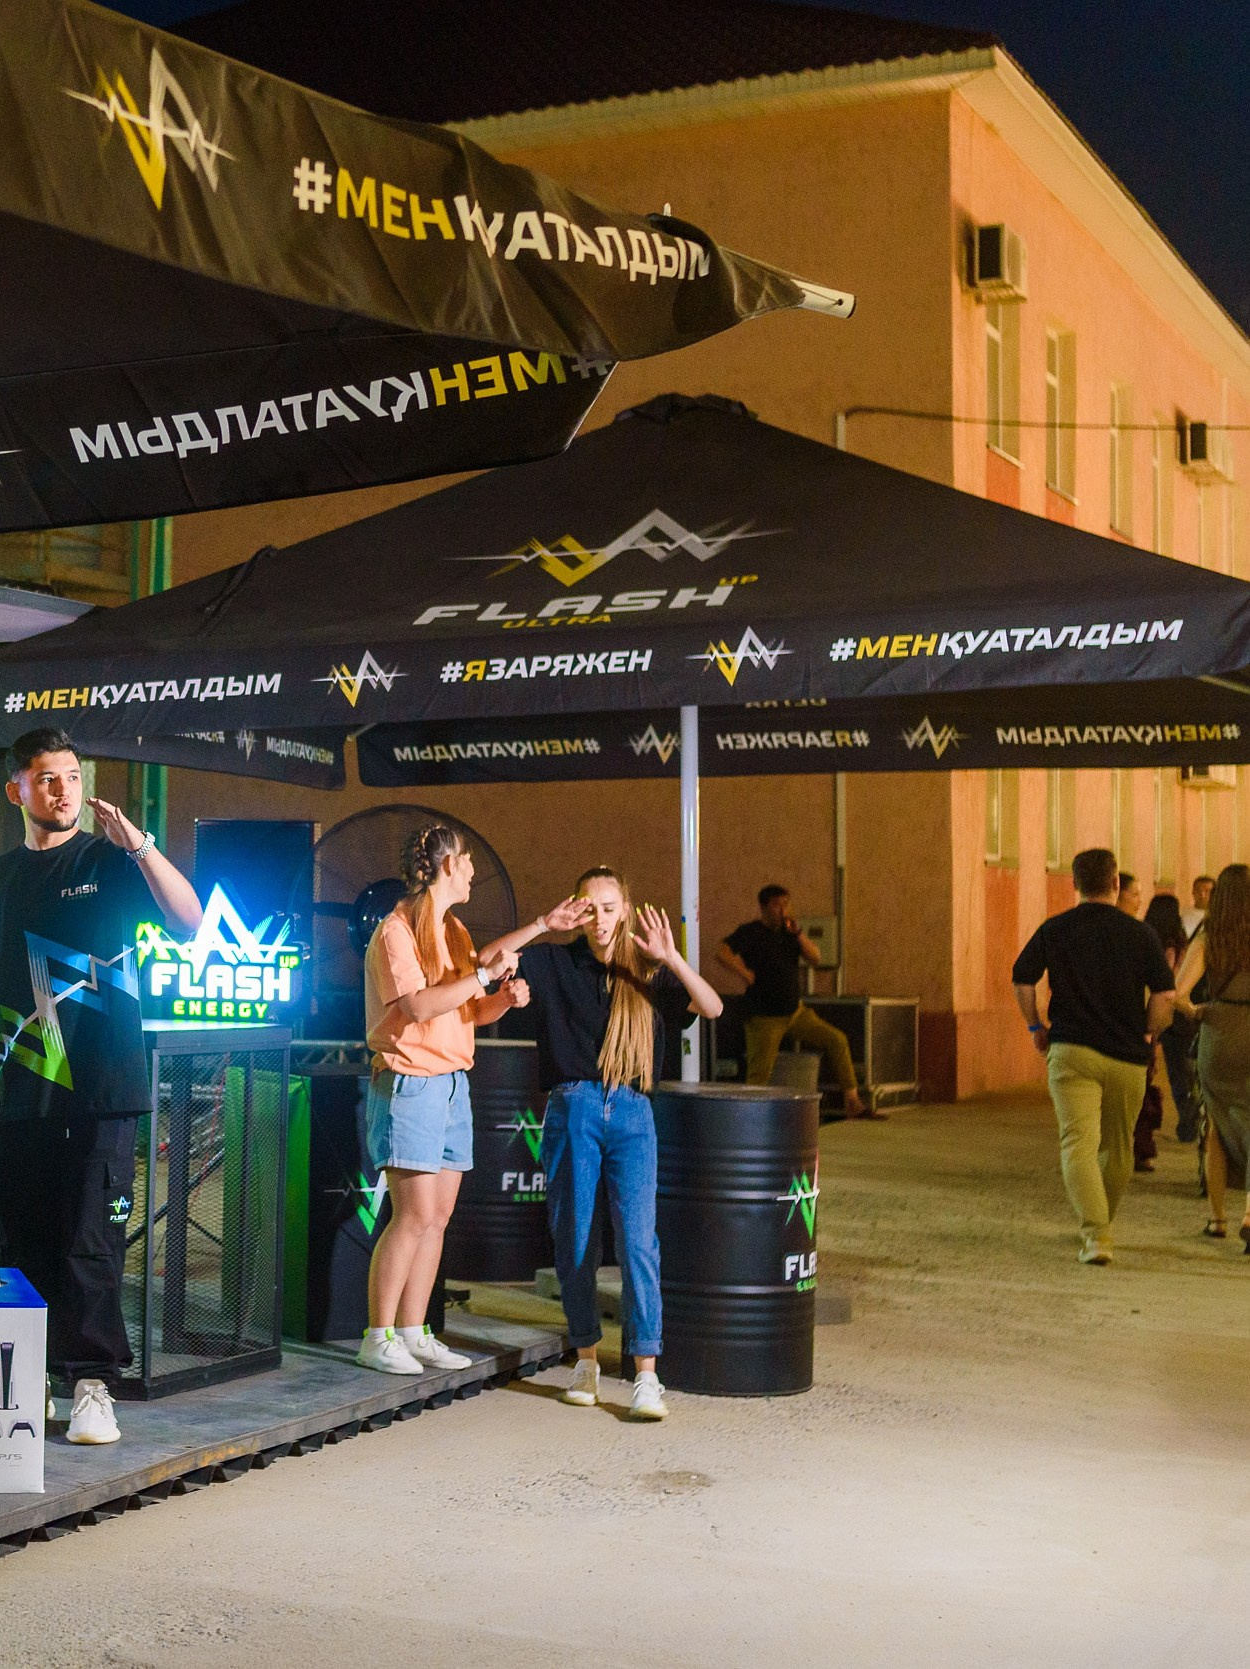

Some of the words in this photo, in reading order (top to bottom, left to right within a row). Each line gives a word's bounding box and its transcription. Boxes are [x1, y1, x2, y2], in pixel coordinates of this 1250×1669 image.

[412, 584, 734, 625] FLASH
[501, 614, 612, 629] ULTRA
[829, 618, 1184, 661] #МЕНҚУАТАЛДЫМ
[439, 648, 652, 684] #ЯЗАРЯЖЕН
[4, 673, 282, 713] #МЕНҚУАТАЛДЫМ
[61, 883, 98, 898] FLASH
[279, 954, 300, 969] UP
[150, 961, 292, 1002] FLASH
[173, 999, 270, 1019] ENERGY
[502, 1171, 547, 1192] FLA
